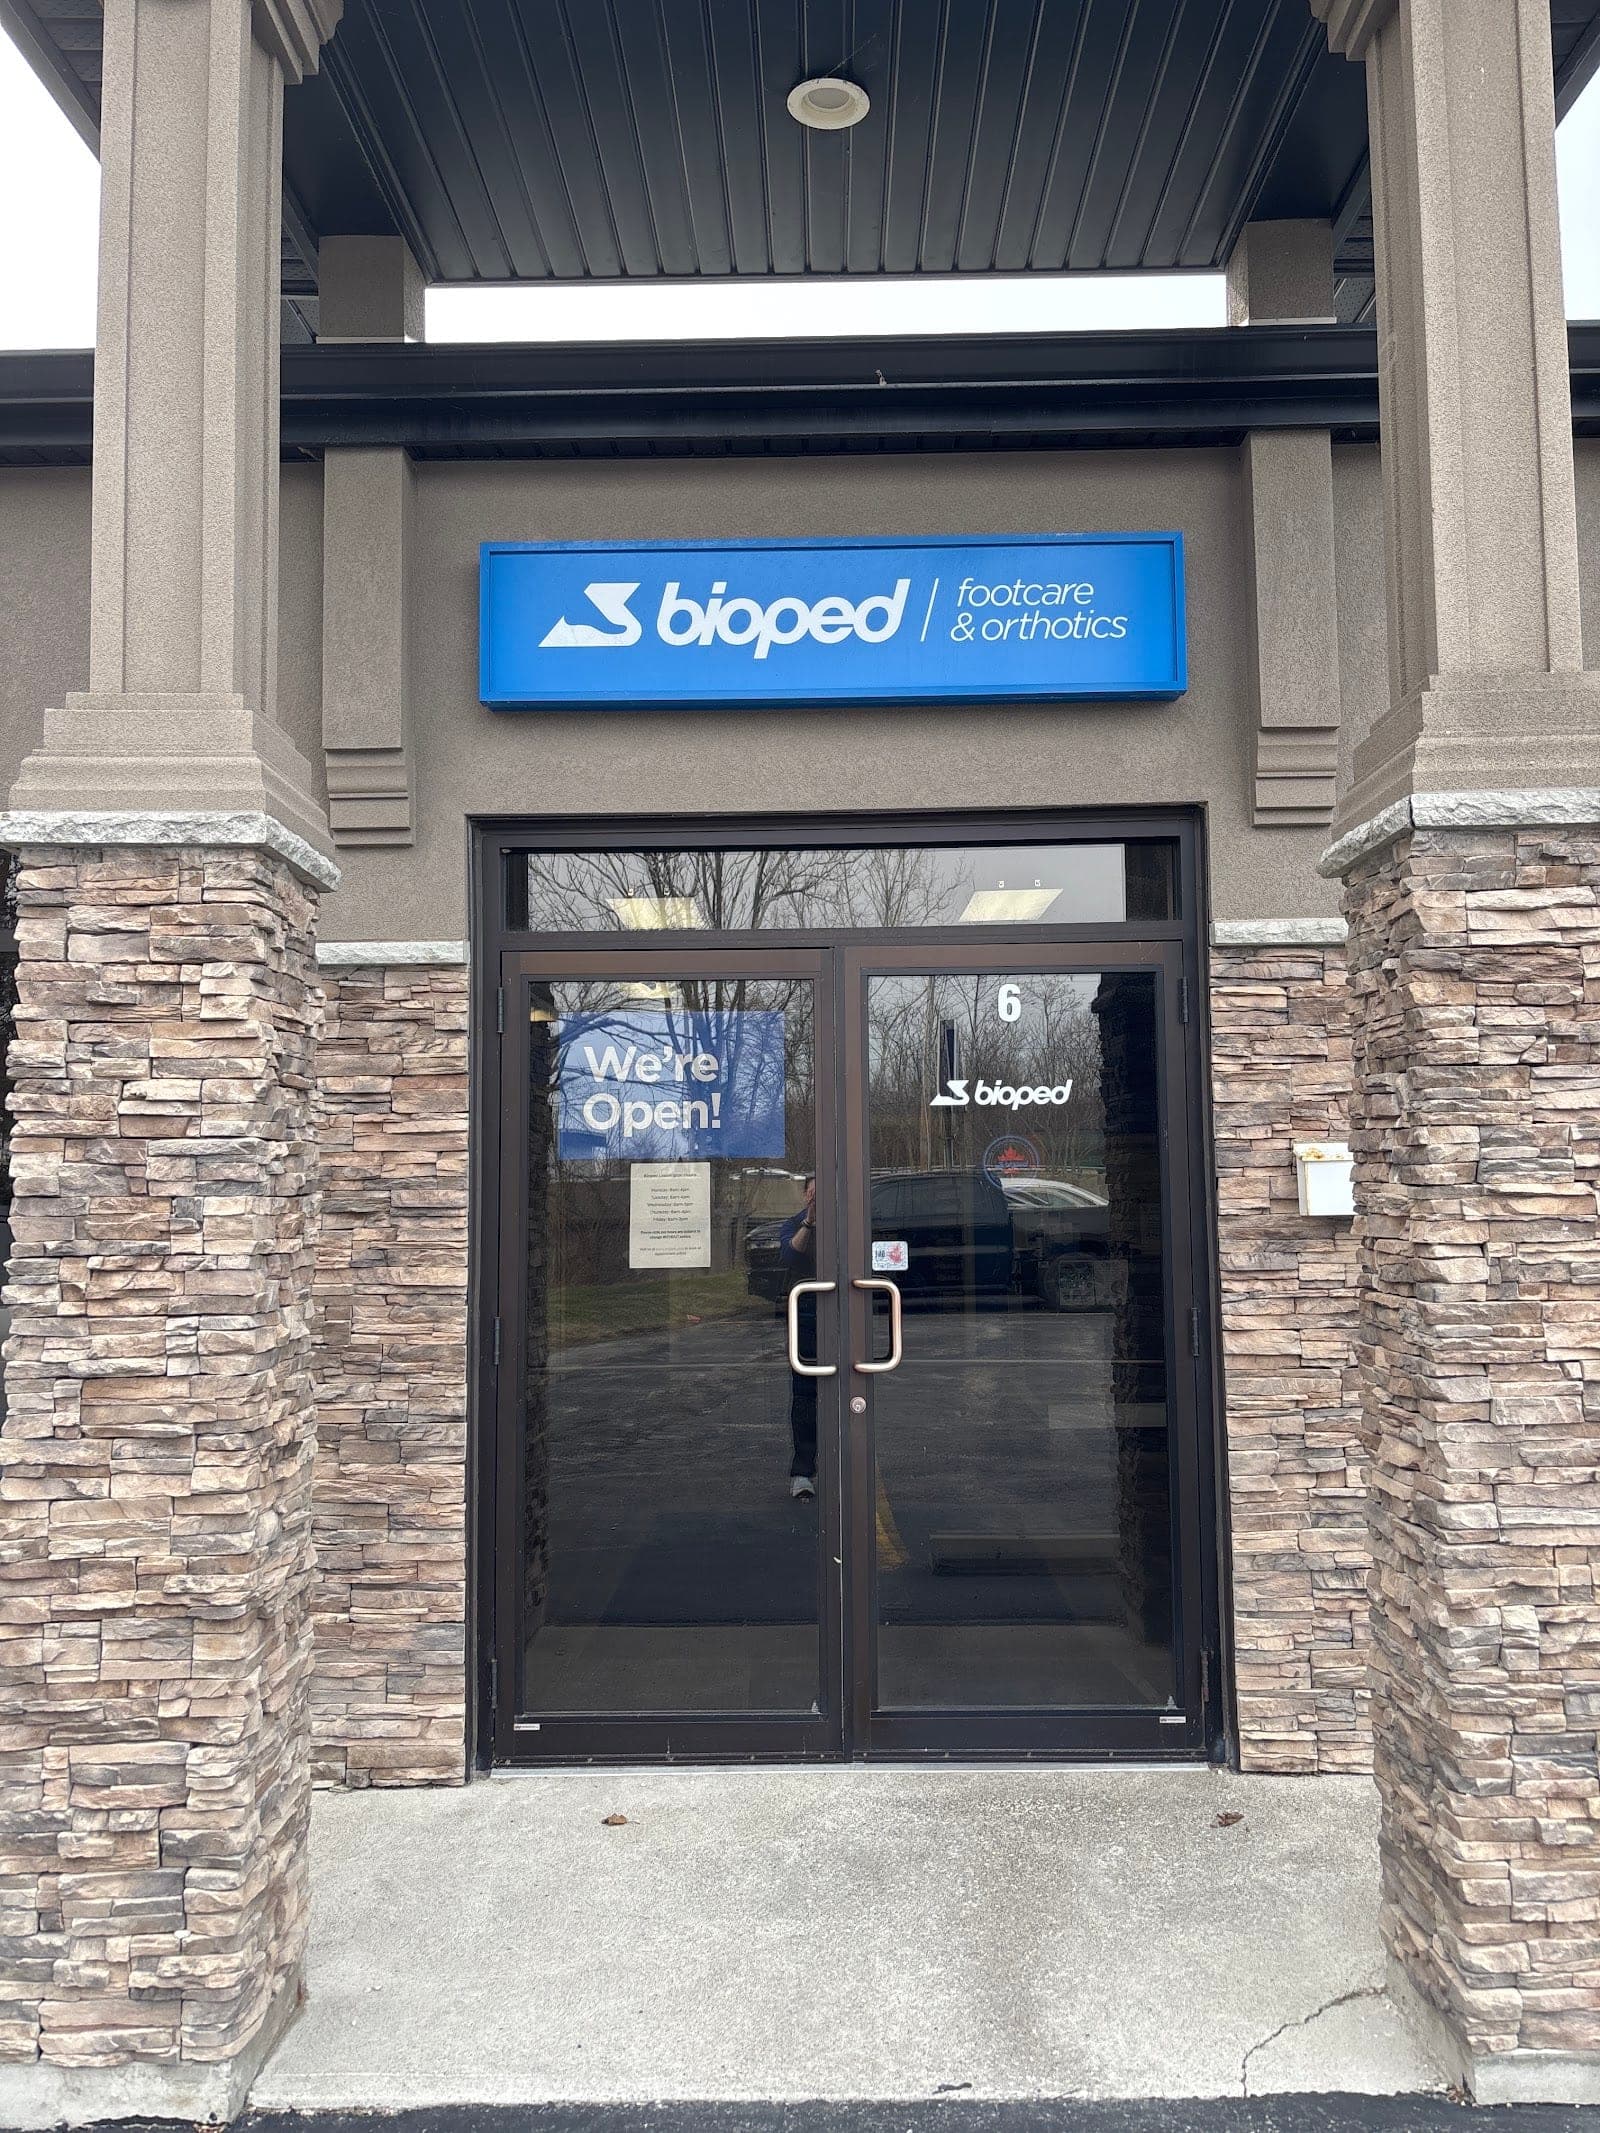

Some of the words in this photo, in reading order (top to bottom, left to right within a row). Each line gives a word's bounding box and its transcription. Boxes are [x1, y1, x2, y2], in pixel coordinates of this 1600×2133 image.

[957, 577, 1094, 608] footcare
[656, 578, 911, 659] bioped
[950, 613, 975, 642] &
[981, 607, 1128, 641] orthotics
[997, 983, 1021, 1023] 6
[584, 1045, 718, 1082] We're
[974, 1079, 1073, 1110] bioped
[583, 1092, 721, 1138] Open!
